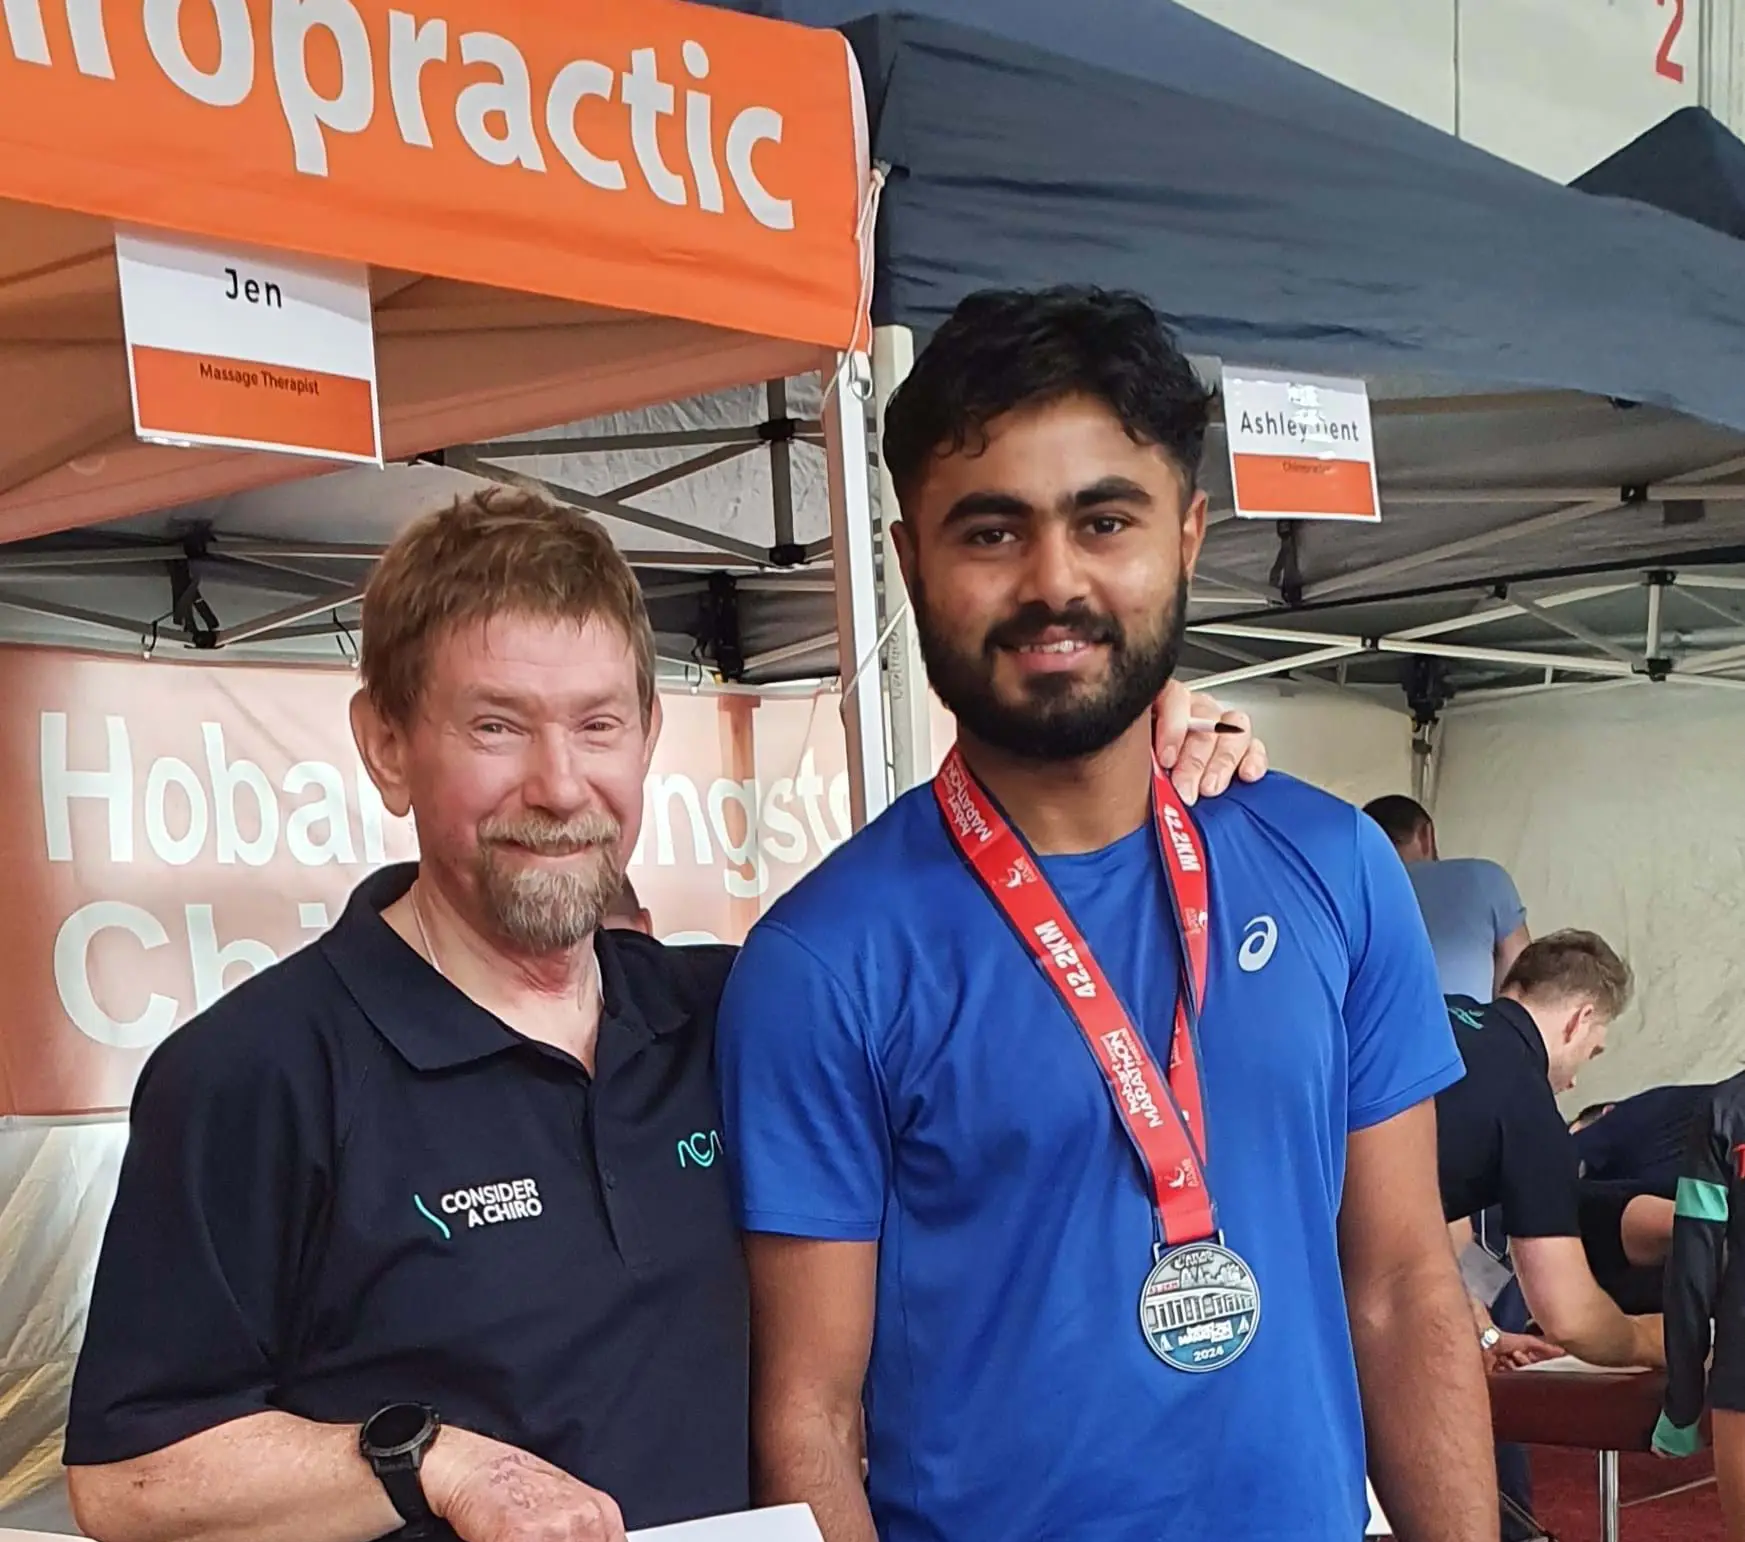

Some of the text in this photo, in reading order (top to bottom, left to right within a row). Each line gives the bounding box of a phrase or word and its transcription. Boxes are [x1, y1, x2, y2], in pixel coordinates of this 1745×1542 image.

[1656, 0, 1683, 84] 2
[225, 267, 282, 309] Jen
[200, 362, 320, 396] Massage Therapist
[1240, 409, 1307, 443] Ashley
[40, 711, 388, 866] Hobar
[1163, 803, 1202, 872] 42.2KM
[1034, 919, 1097, 999] 42.2KM
[1112, 1061, 1141, 1116] hobart
[441, 1178, 539, 1214] CONSIDER
[467, 1198, 543, 1228] A CHIRO
[1193, 1345, 1224, 1362] 2024
